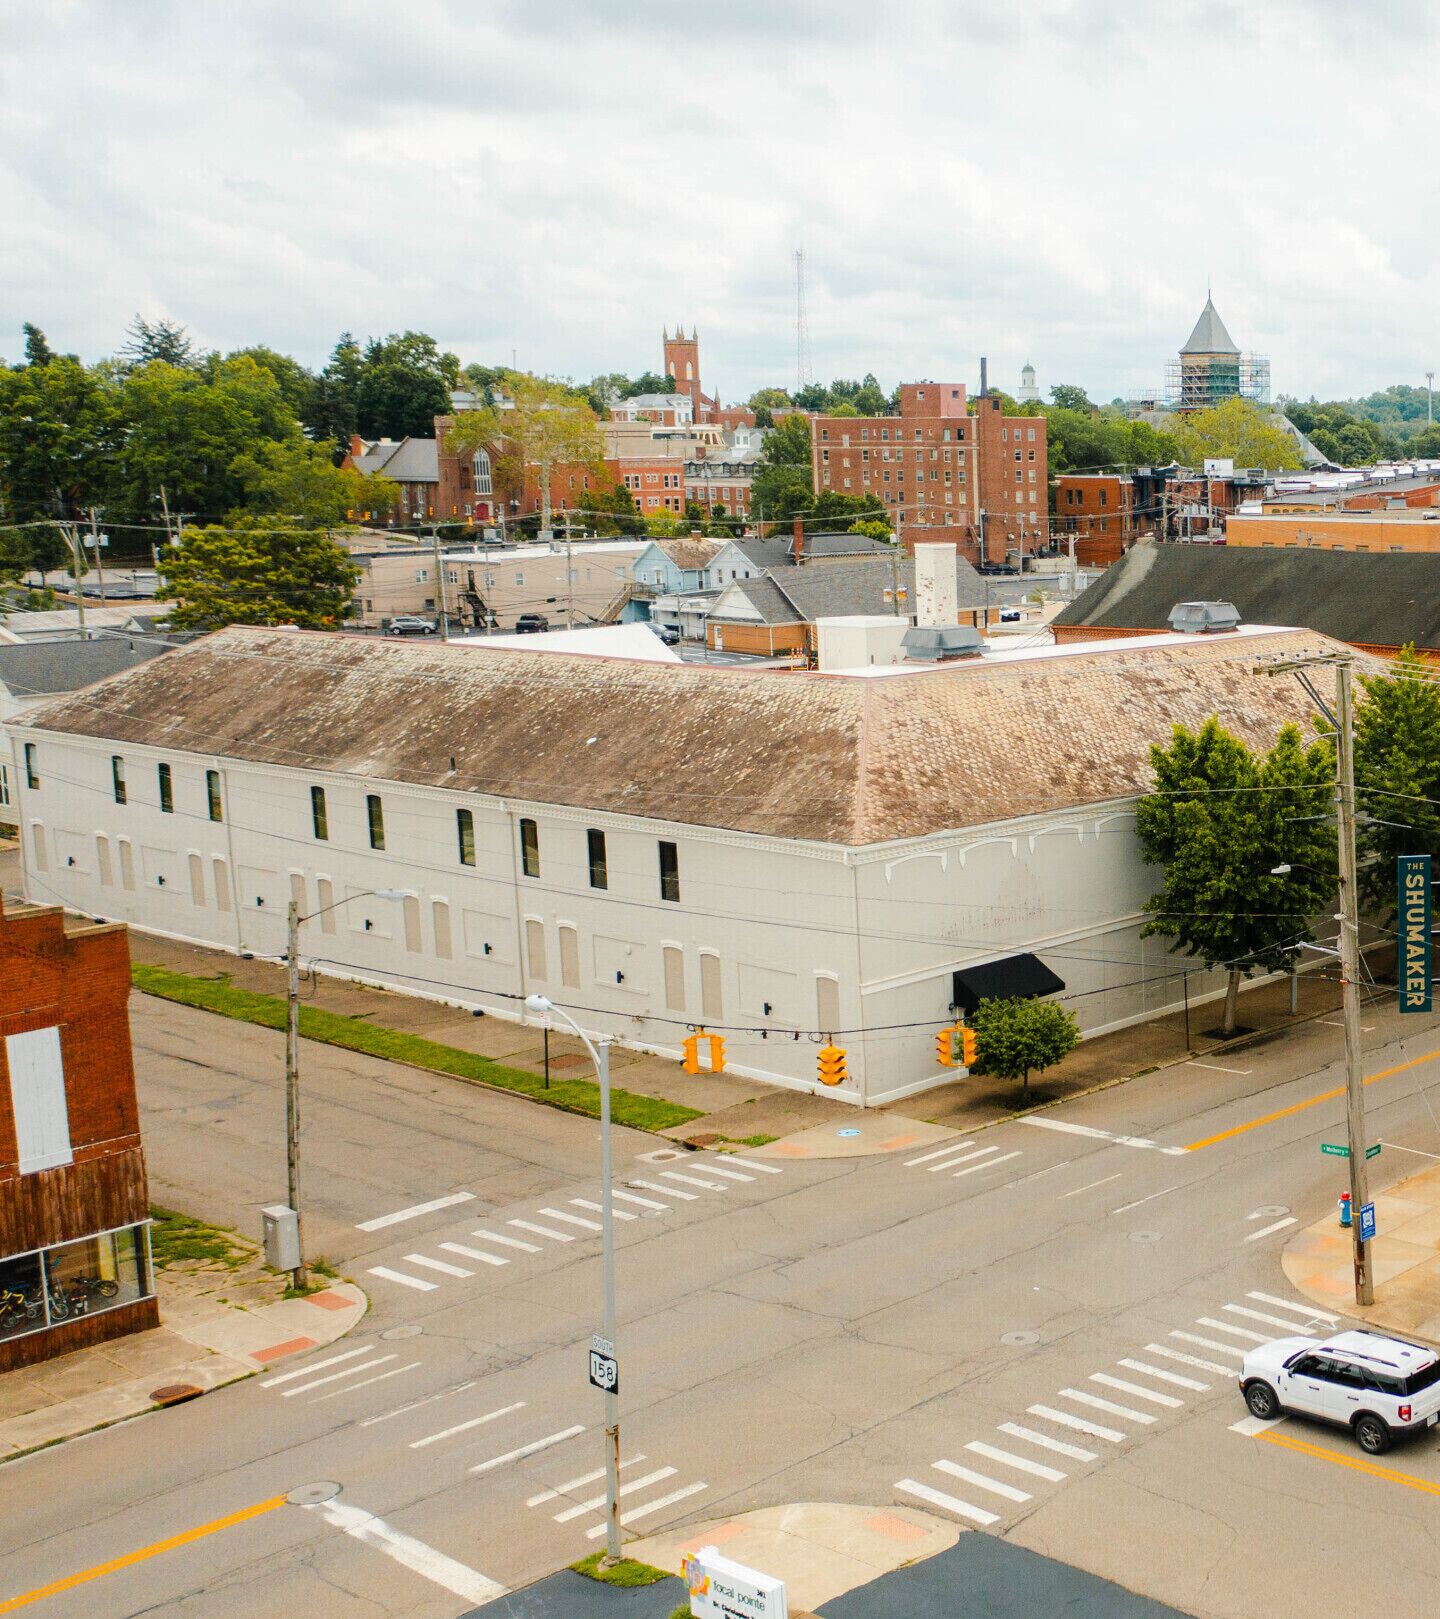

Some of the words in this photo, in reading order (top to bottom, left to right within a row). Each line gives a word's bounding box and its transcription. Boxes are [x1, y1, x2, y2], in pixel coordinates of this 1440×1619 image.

[1407, 862, 1424, 870] THE
[1405, 874, 1425, 1006] SHUMAKER
[593, 1337, 614, 1353] SOUTH
[593, 1360, 614, 1382] 158
[713, 1580, 735, 1598] focal
[738, 1592, 765, 1611] pointe
